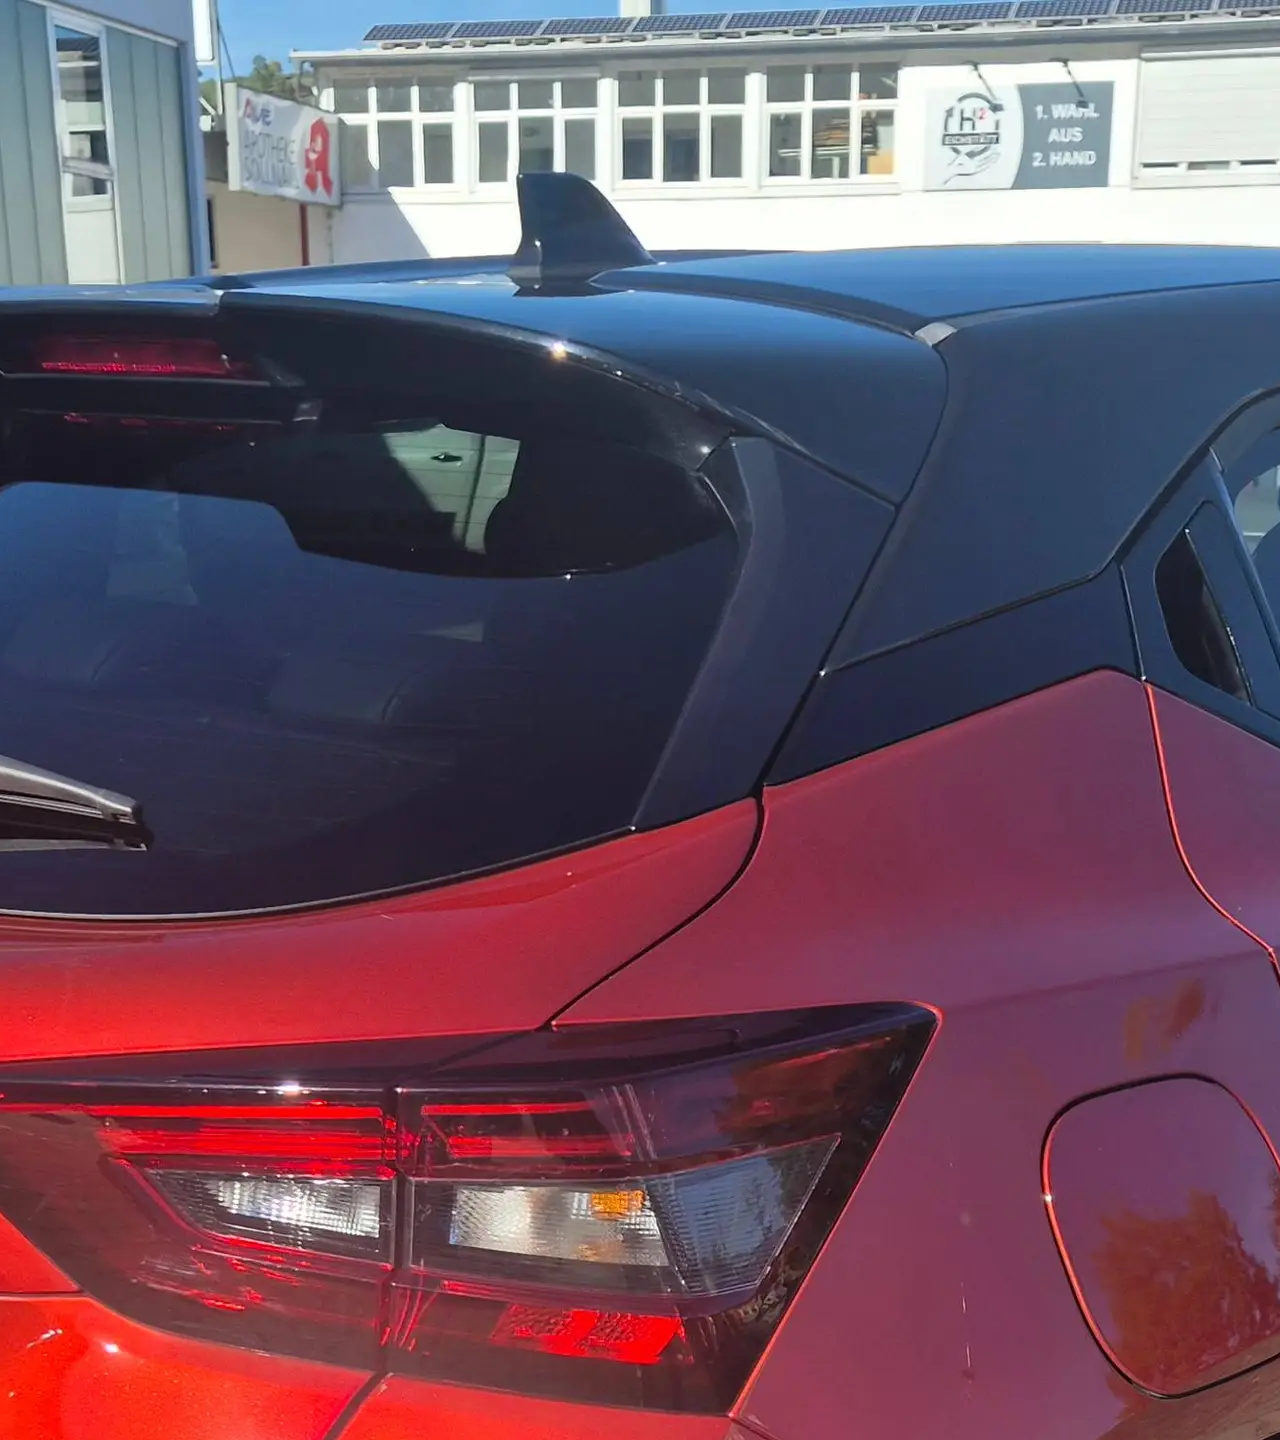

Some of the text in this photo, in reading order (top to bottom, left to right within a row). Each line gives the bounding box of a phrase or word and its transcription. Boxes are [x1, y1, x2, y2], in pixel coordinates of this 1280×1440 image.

[1035, 104, 1049, 120] 1.
[1048, 127, 1083, 143] AUS
[1032, 150, 1097, 167] 2. HAND
